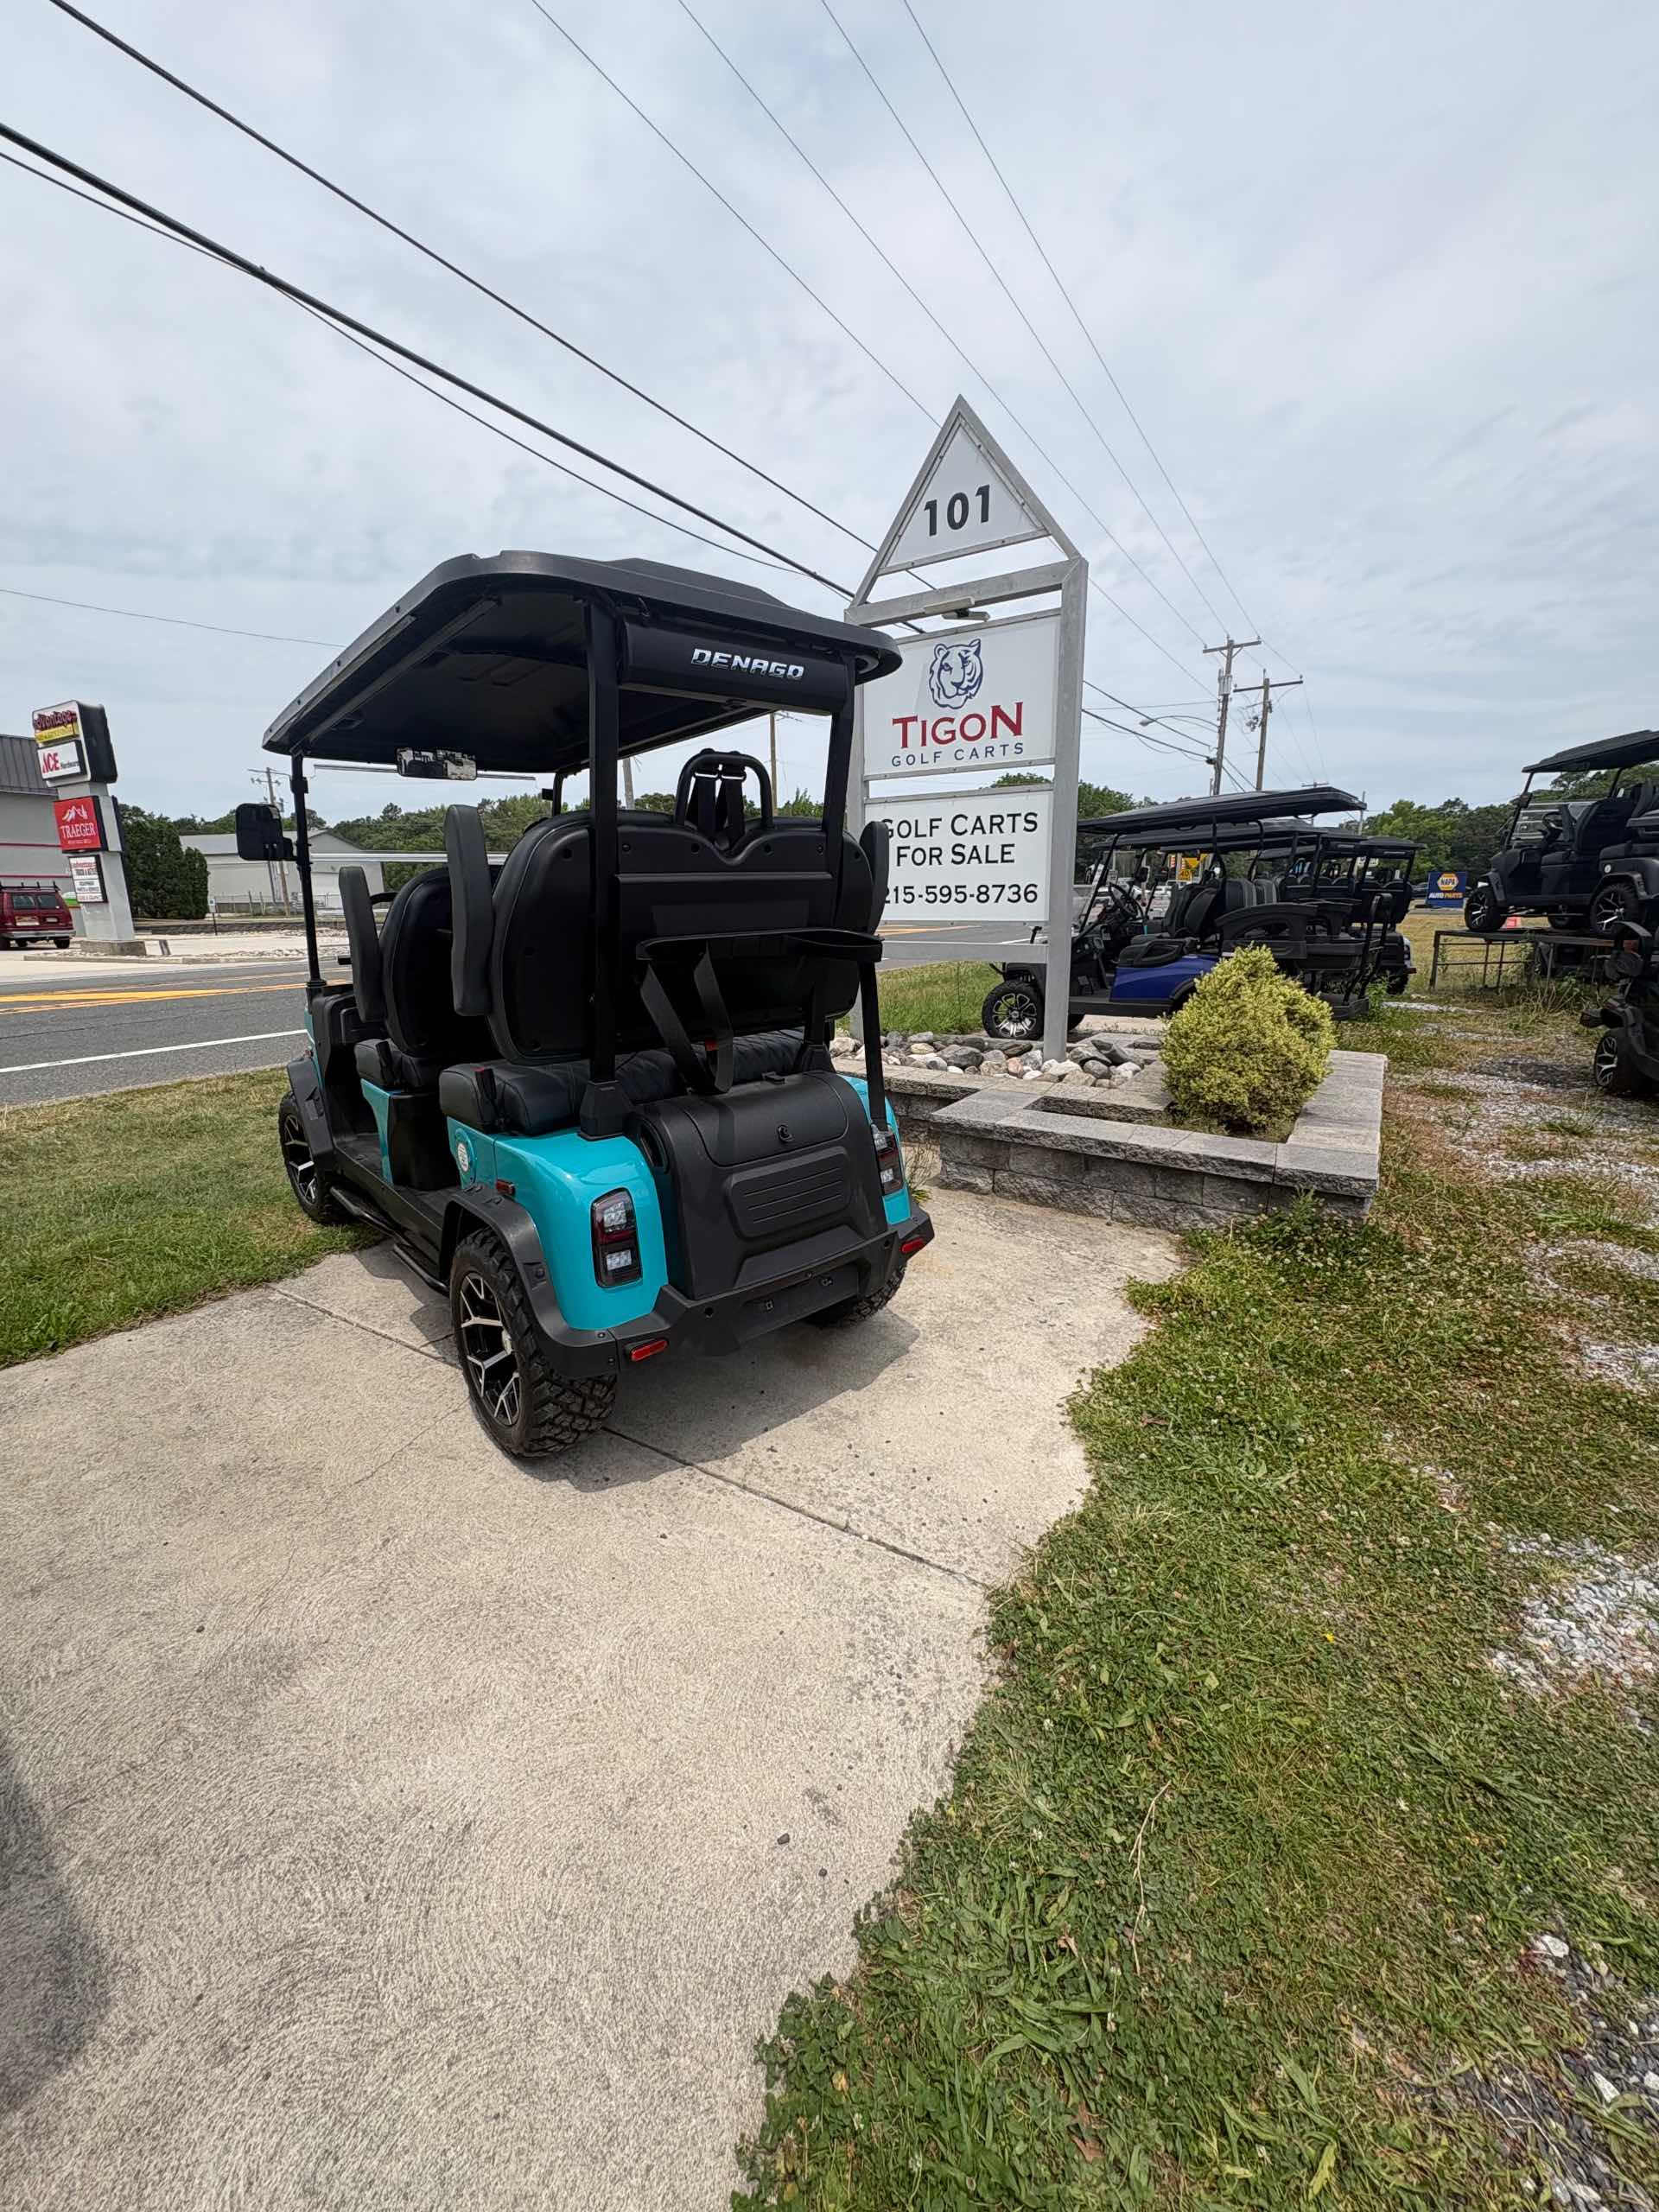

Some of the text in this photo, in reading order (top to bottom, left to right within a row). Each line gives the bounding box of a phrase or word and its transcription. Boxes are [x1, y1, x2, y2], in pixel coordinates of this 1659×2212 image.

[924, 484, 990, 537] 101
[690, 648, 804, 680] DENAGO
[892, 701, 1024, 749] TIGON
[41, 752, 60, 774] ACE
[891, 742, 1024, 767] GOLF CARTS
[60, 822, 97, 839] TRAEGER
[950, 811, 1039, 836] CARTS
[896, 842, 1016, 868] FOR SALE
[1439, 877, 1457, 886] NAPA
